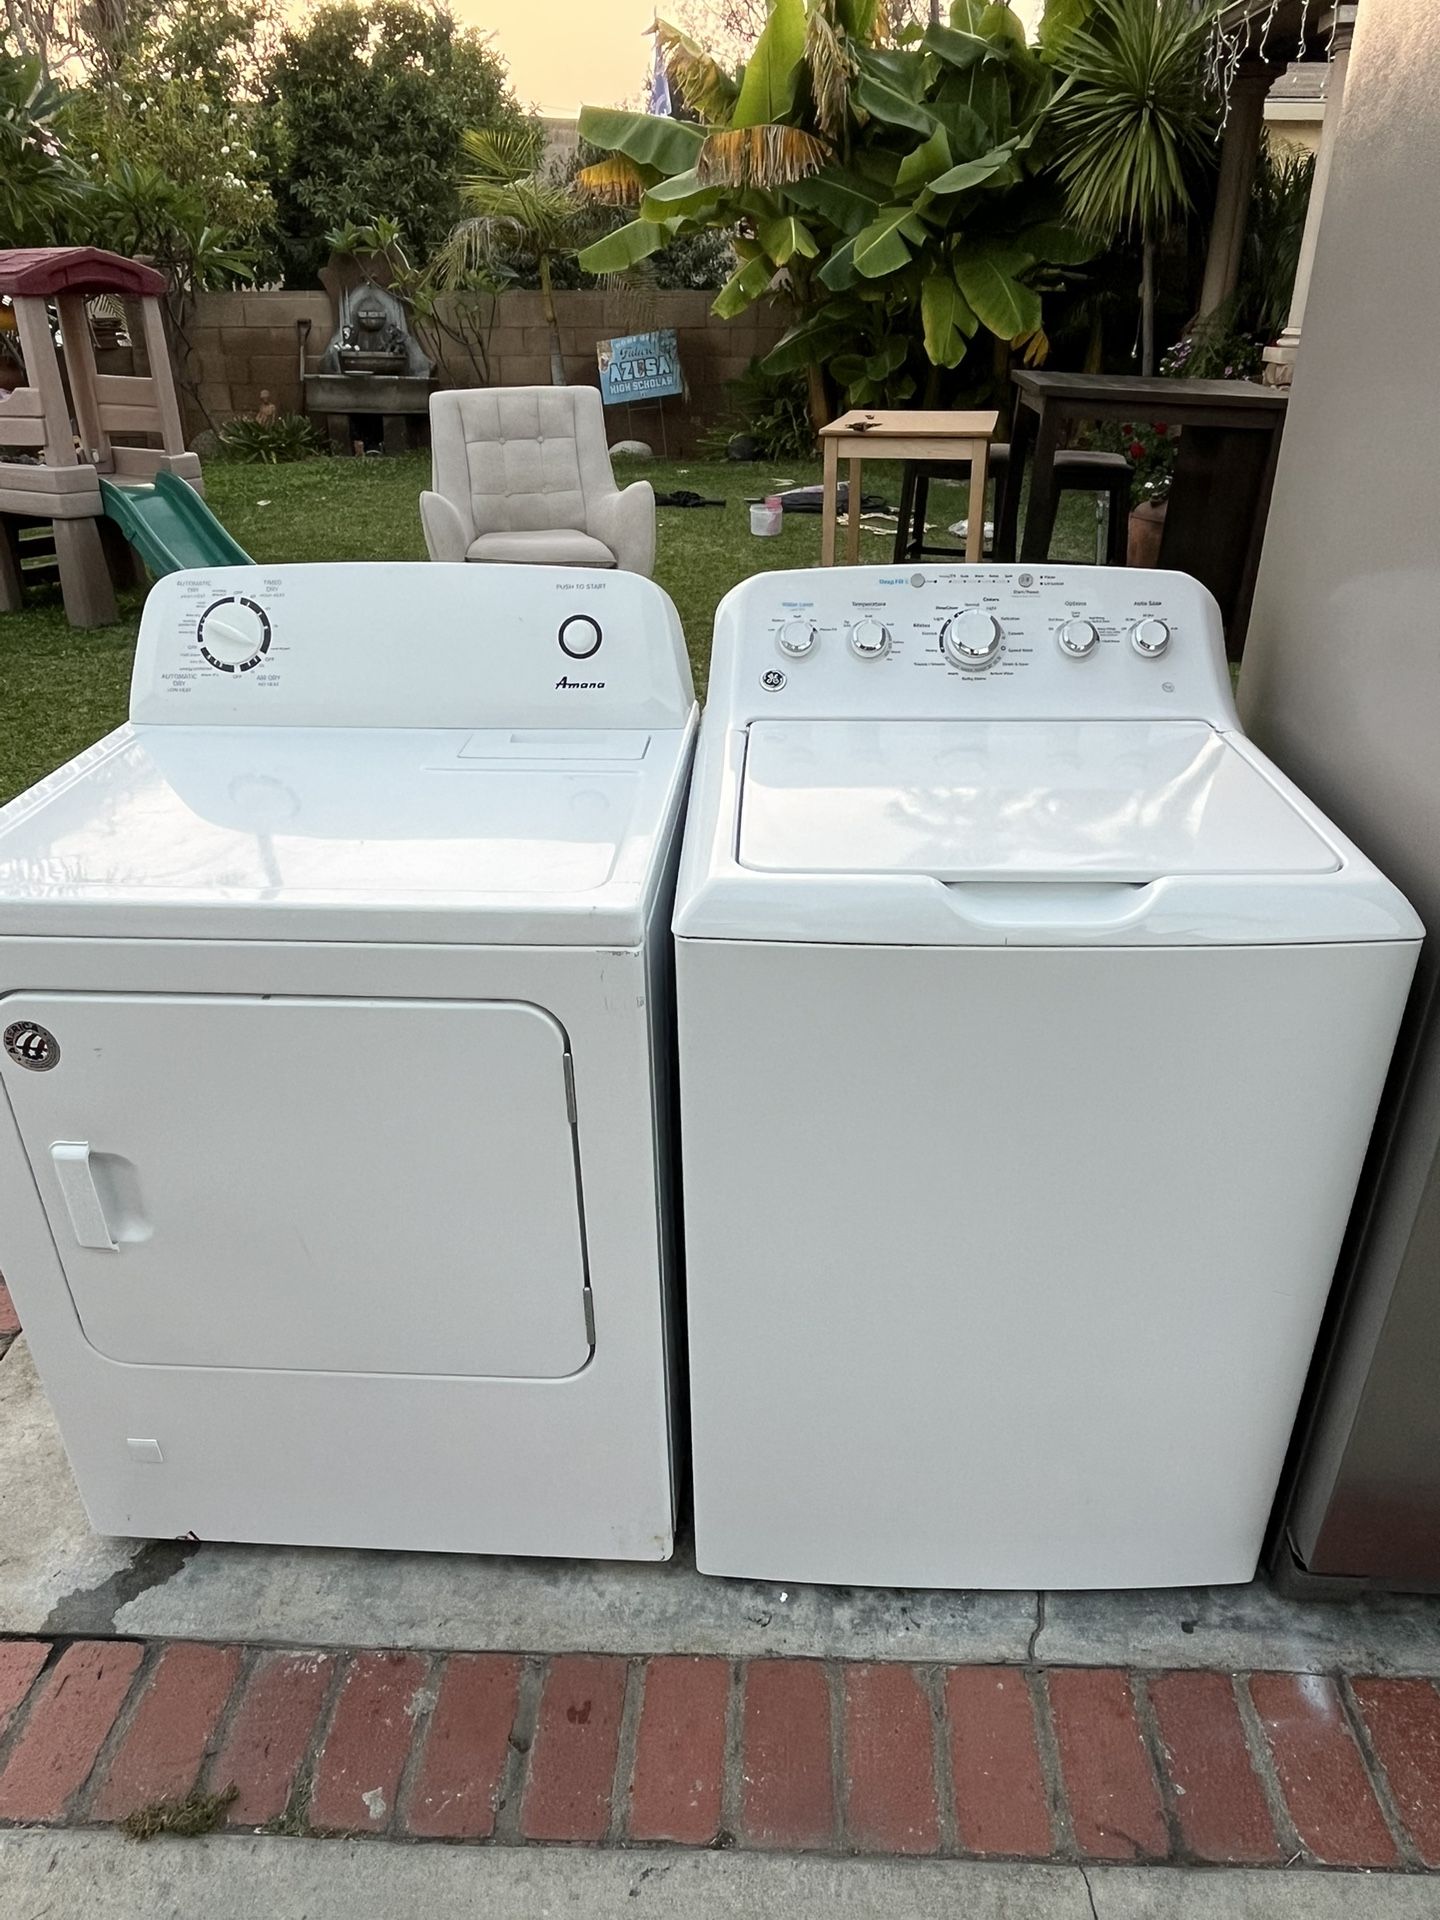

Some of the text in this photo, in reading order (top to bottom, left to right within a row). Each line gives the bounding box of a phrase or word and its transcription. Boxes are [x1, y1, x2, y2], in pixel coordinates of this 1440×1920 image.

[609, 355, 672, 383] AZUSA
[609, 382, 631, 395] HIGH
[632, 376, 673, 391] SCHOLAR
[161, 673, 198, 681] AUTOMATIC
[555, 676, 606, 690] Amana
